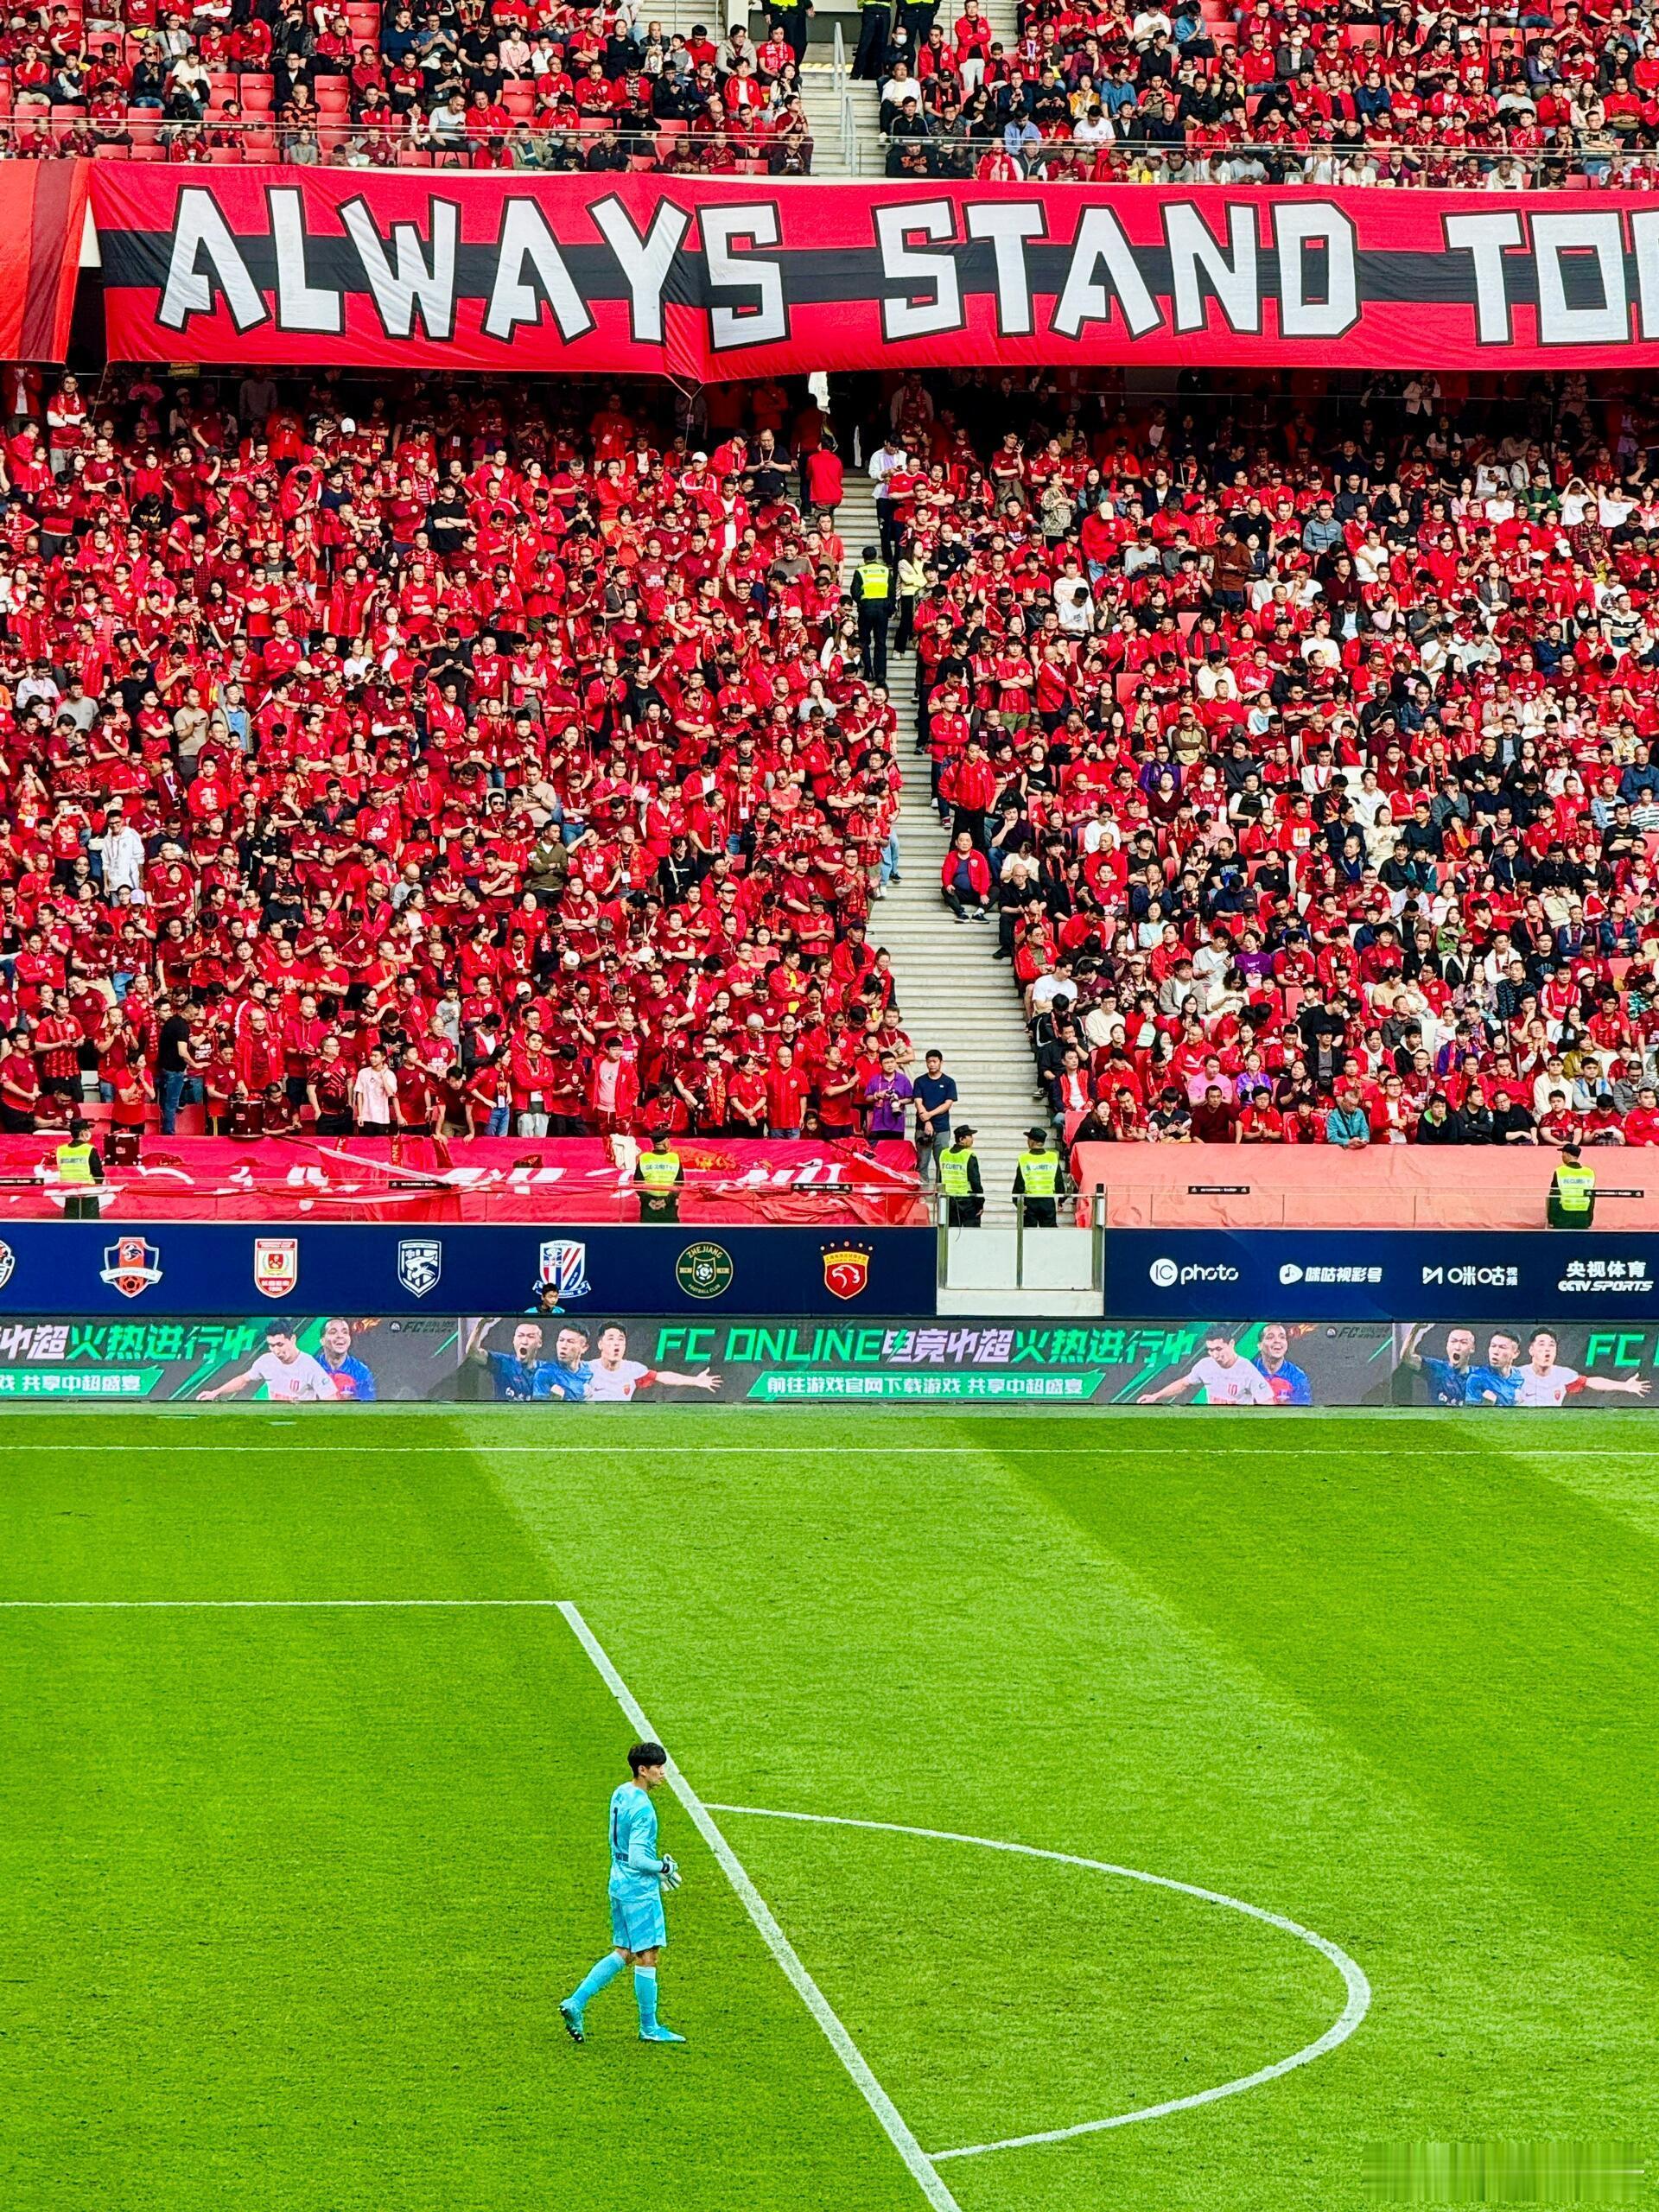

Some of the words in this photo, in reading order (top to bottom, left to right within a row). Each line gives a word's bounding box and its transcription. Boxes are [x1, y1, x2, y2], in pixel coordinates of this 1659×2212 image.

[156, 184, 791, 353] ALWAYS
[871, 195, 1363, 342] STAND
[686, 1245, 723, 1259] ZHEJIANG
[1180, 1263, 1239, 1286] photo
[1304, 1267, 1382, 1283] 咪咕视彩号
[1566, 1261, 1647, 1279] 央视体育
[1591, 1280, 1655, 1292] SPORTS
[0, 1324, 258, 1361] 中超火热进行中
[655, 1327, 716, 1361] FC
[1585, 1333, 1645, 1367] FC
[22, 1375, 141, 1392] 共享中超盛宴
[767, 1376, 961, 1394] 前往游戏官网下载游戏
[968, 1377, 1084, 1395] 共享中超盛宴
[613, 1807, 619, 1847] 1
